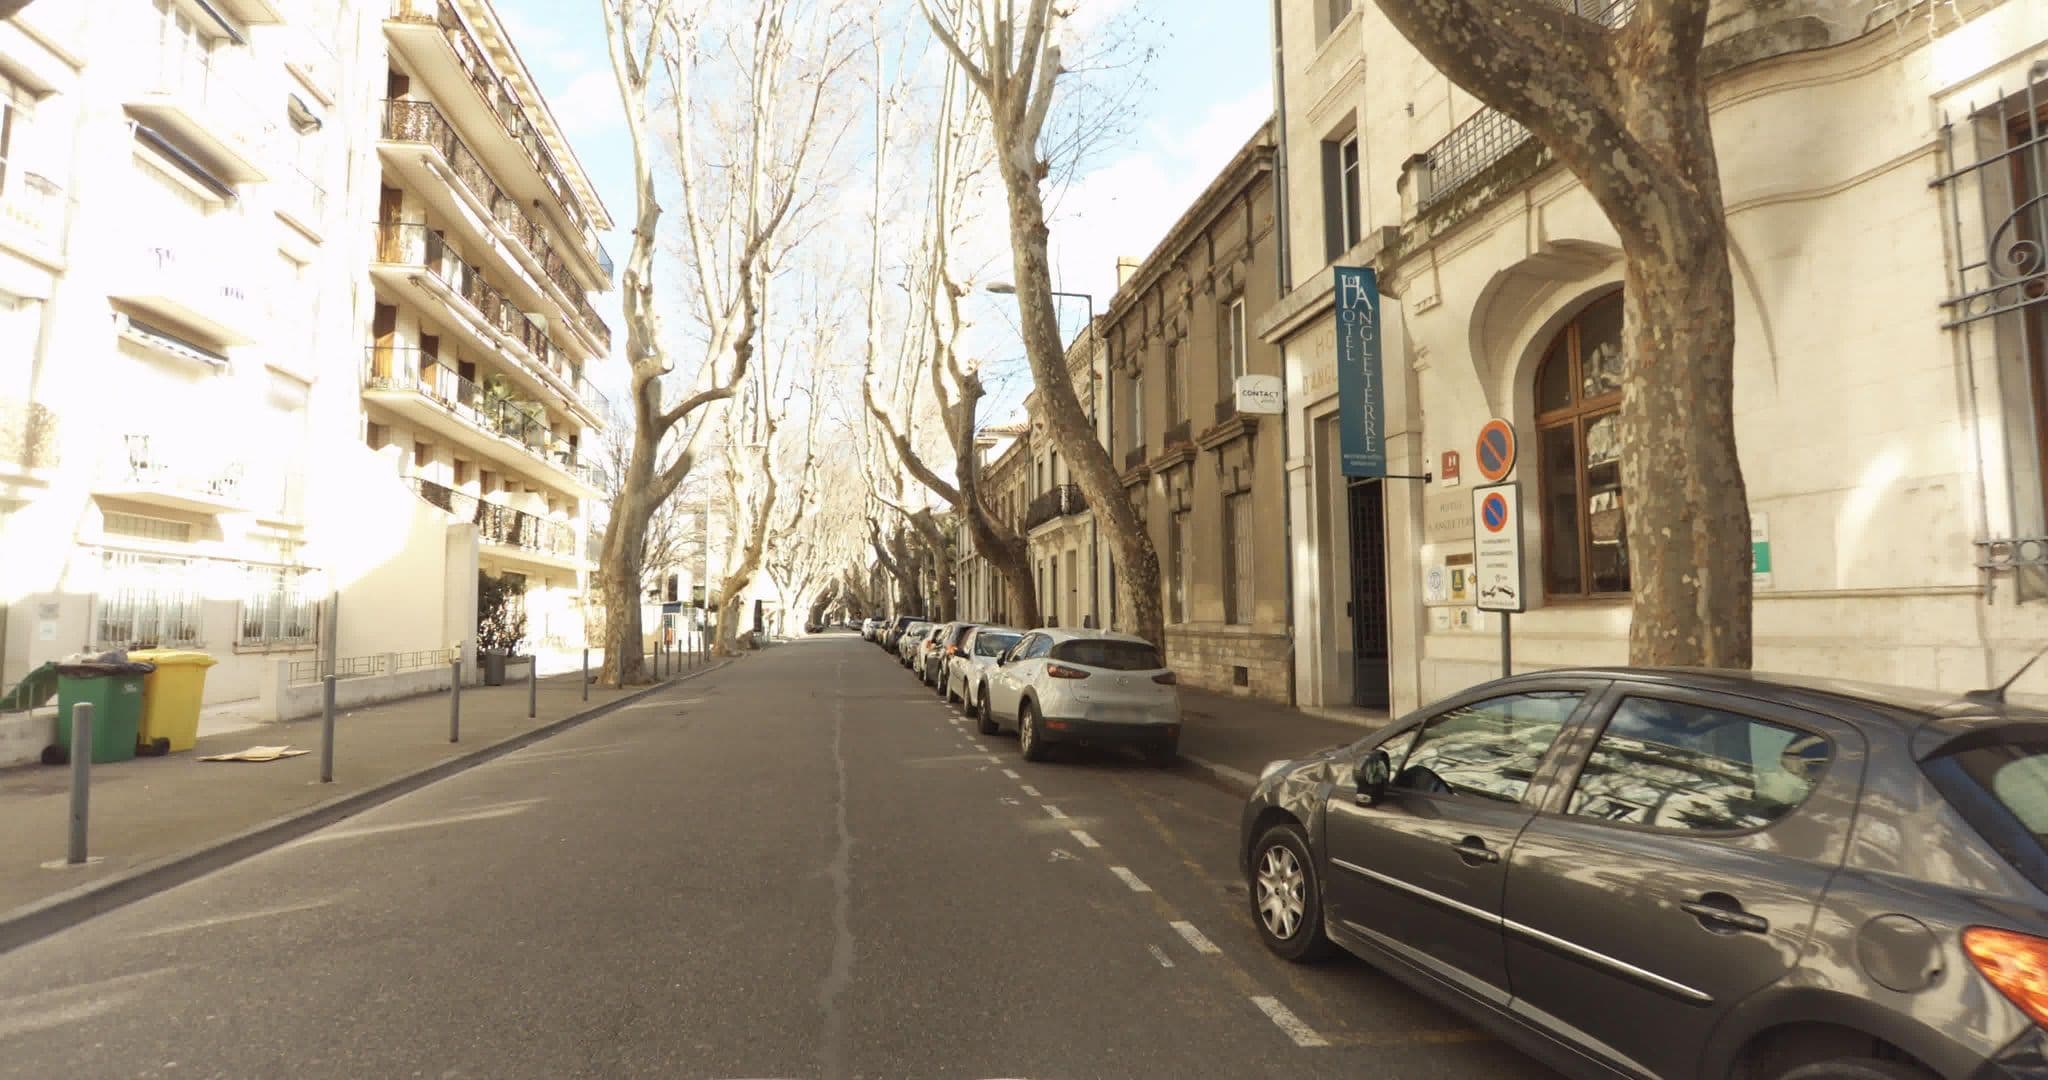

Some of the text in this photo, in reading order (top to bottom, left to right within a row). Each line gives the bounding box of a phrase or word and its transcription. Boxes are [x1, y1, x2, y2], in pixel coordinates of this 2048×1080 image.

[1341, 274, 1360, 361] HOTEL
[1242, 389, 1279, 398] CONTACT
[1352, 286, 1376, 452] ANGLETERRE
